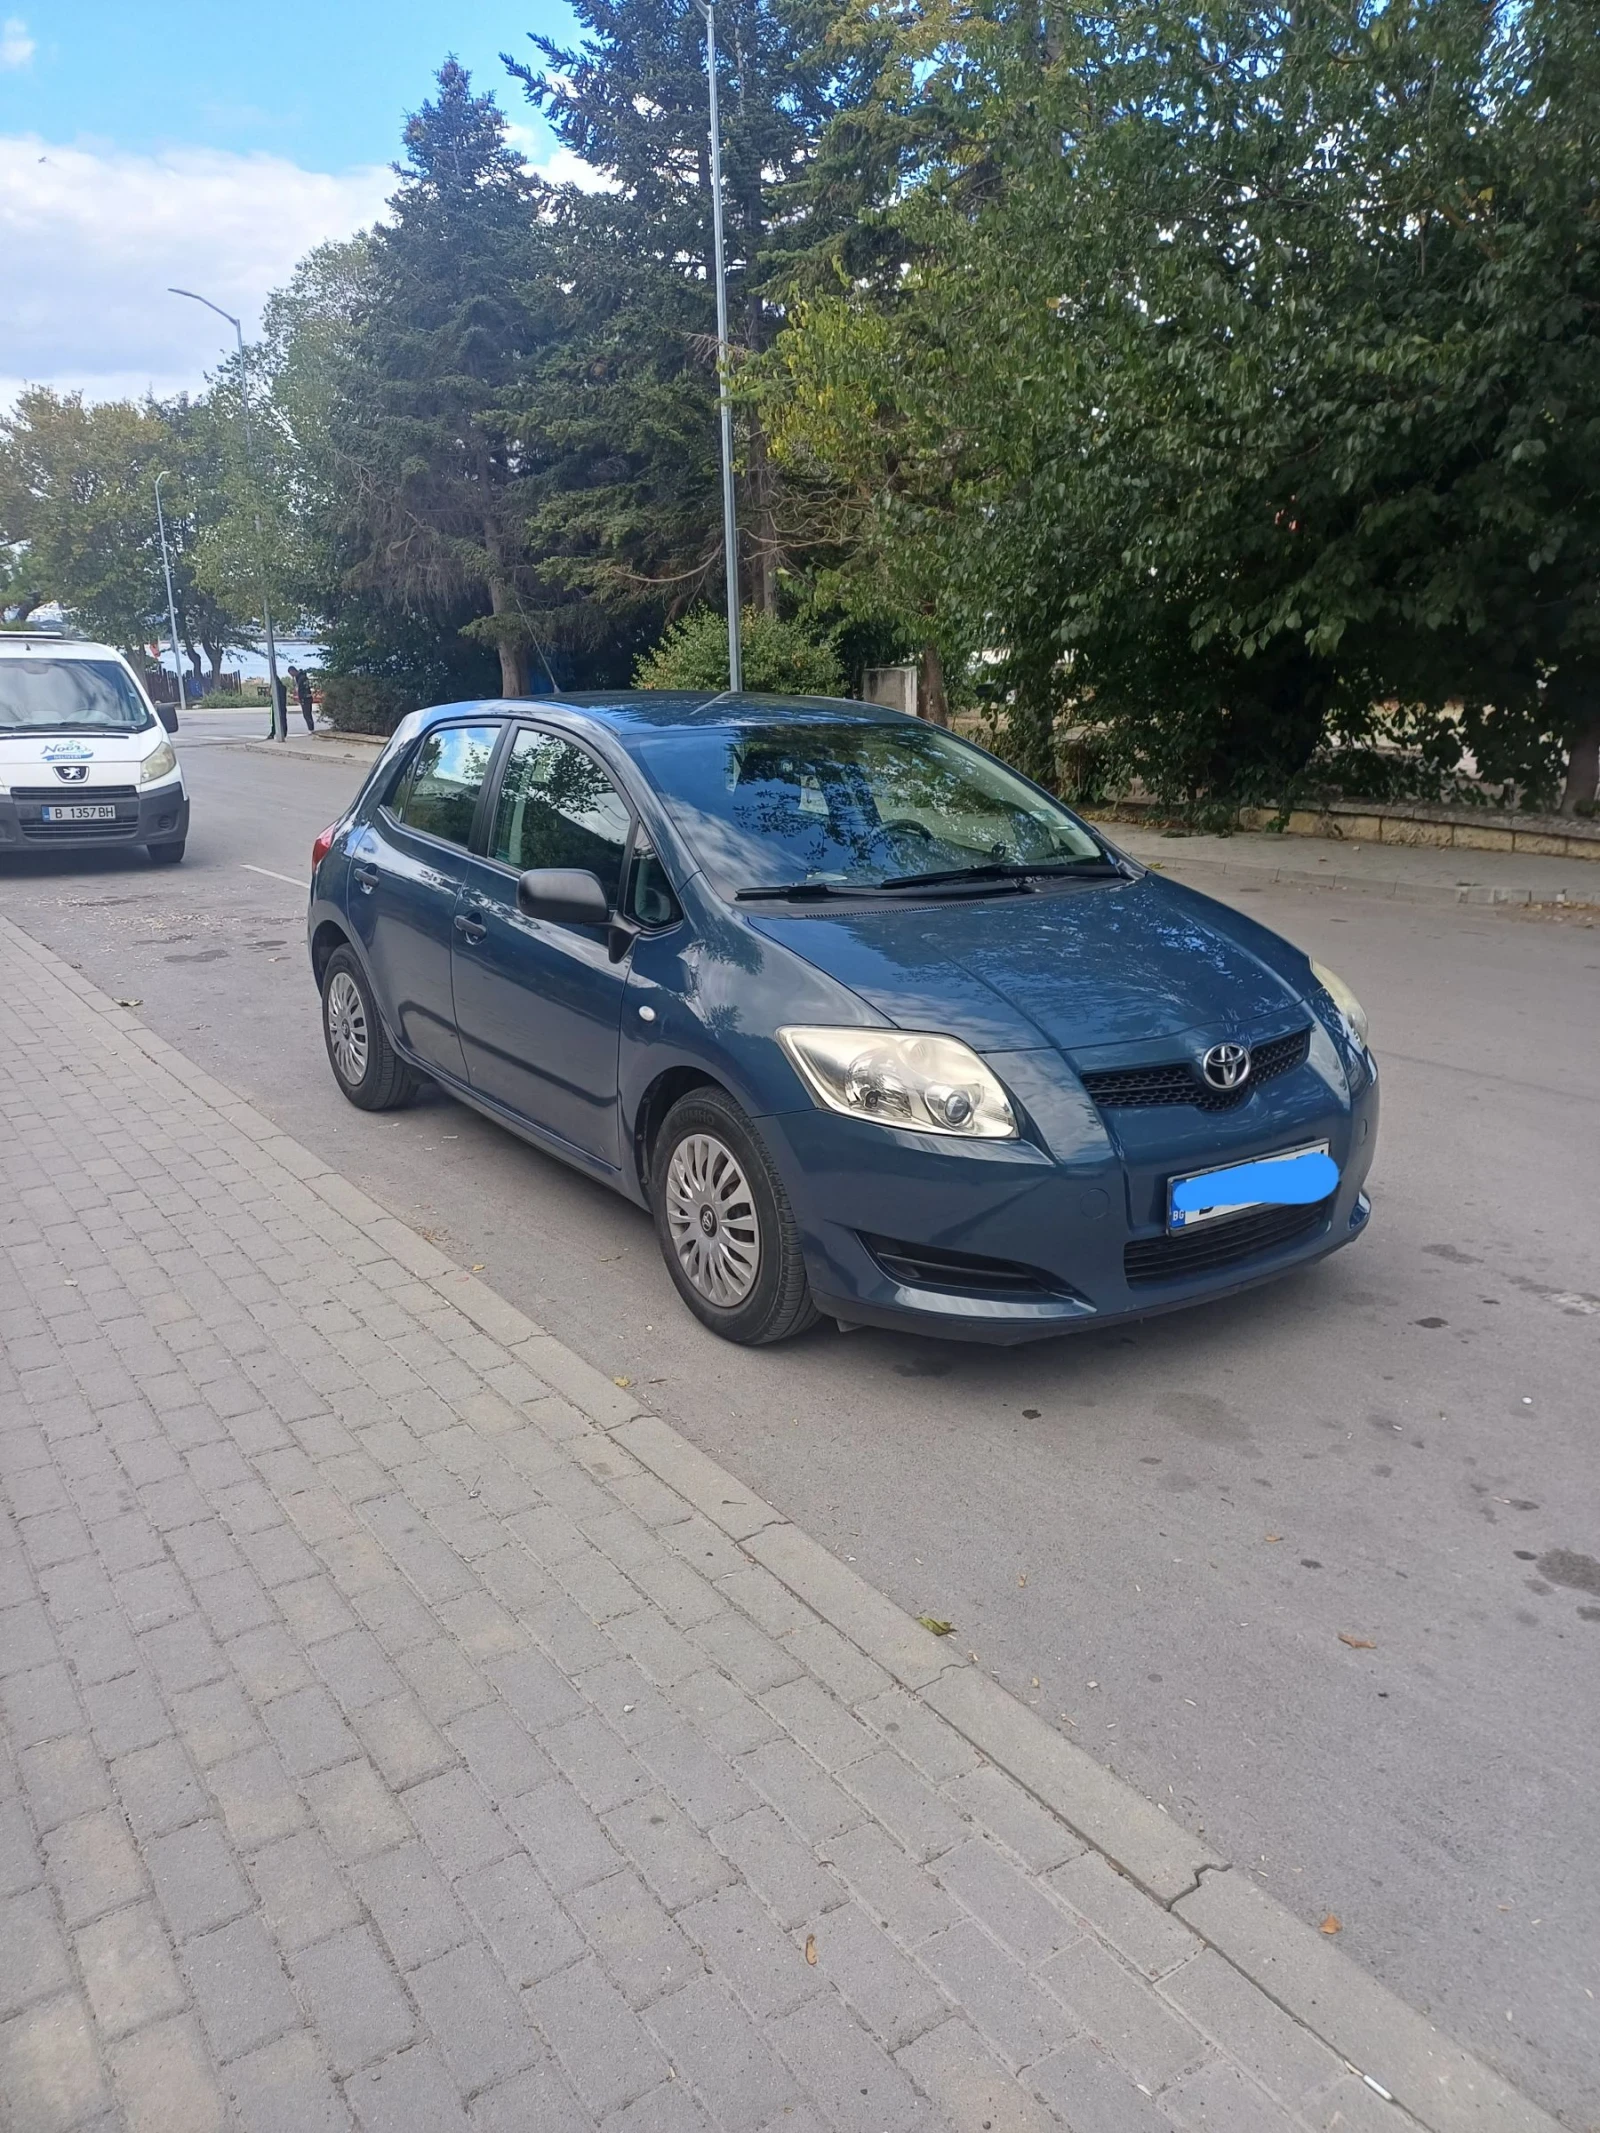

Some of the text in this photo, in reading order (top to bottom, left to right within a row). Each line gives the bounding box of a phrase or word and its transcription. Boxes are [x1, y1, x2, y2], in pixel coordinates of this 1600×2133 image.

[55, 806, 114, 819] B 1357 BH
[1173, 1210, 1185, 1221] BG
